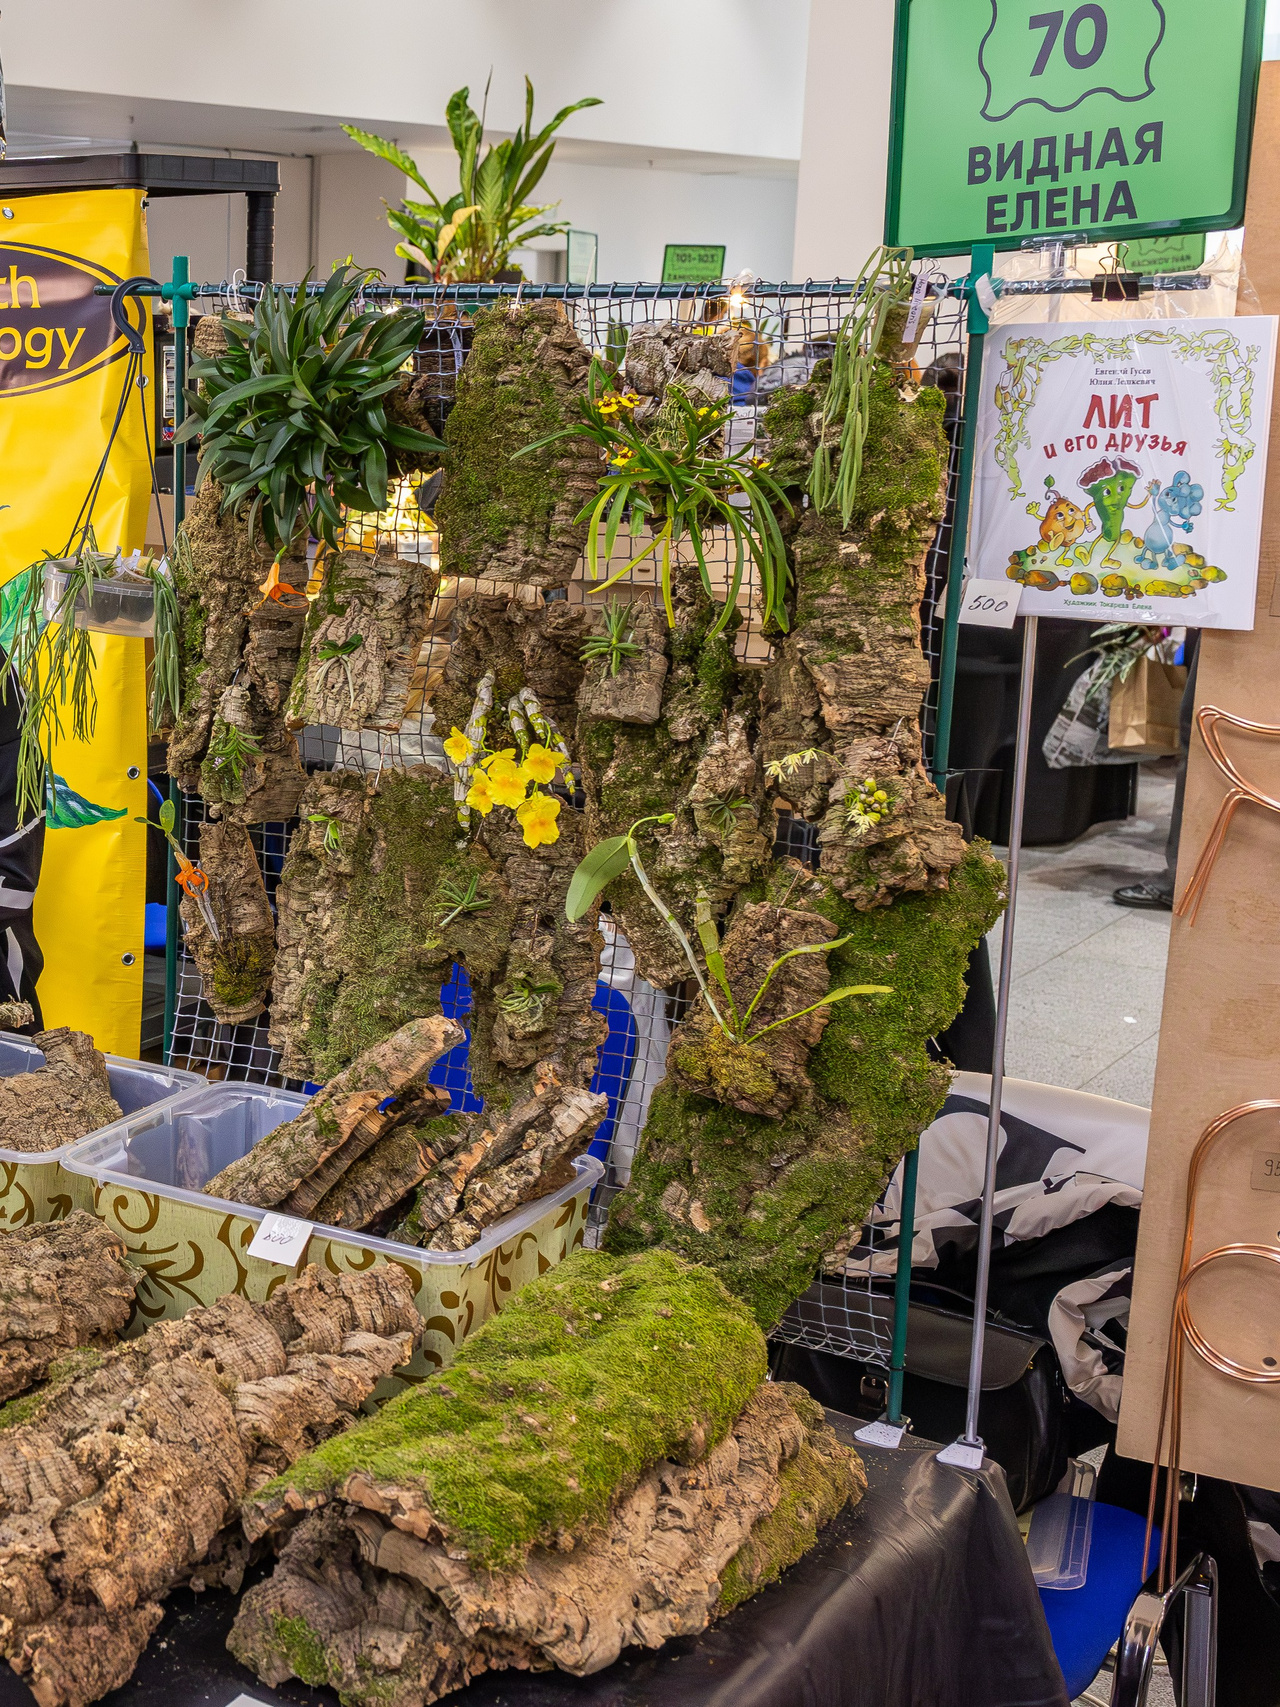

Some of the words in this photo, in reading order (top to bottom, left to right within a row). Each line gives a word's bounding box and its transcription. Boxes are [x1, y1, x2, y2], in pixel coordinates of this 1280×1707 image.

[1028, 3, 1108, 77] 70
[967, 121, 1164, 185] ВИДНАЯ
[986, 180, 1138, 234] ЕЛЕНА
[1130, 367, 1152, 376] Гусев
[1082, 393, 1159, 429] ЛИТ
[1043, 443, 1058, 459] и
[1064, 434, 1098, 453] его
[1104, 432, 1188, 457] друзья
[968, 595, 1009, 612] 500
[1063, 599, 1097, 607] Художник
